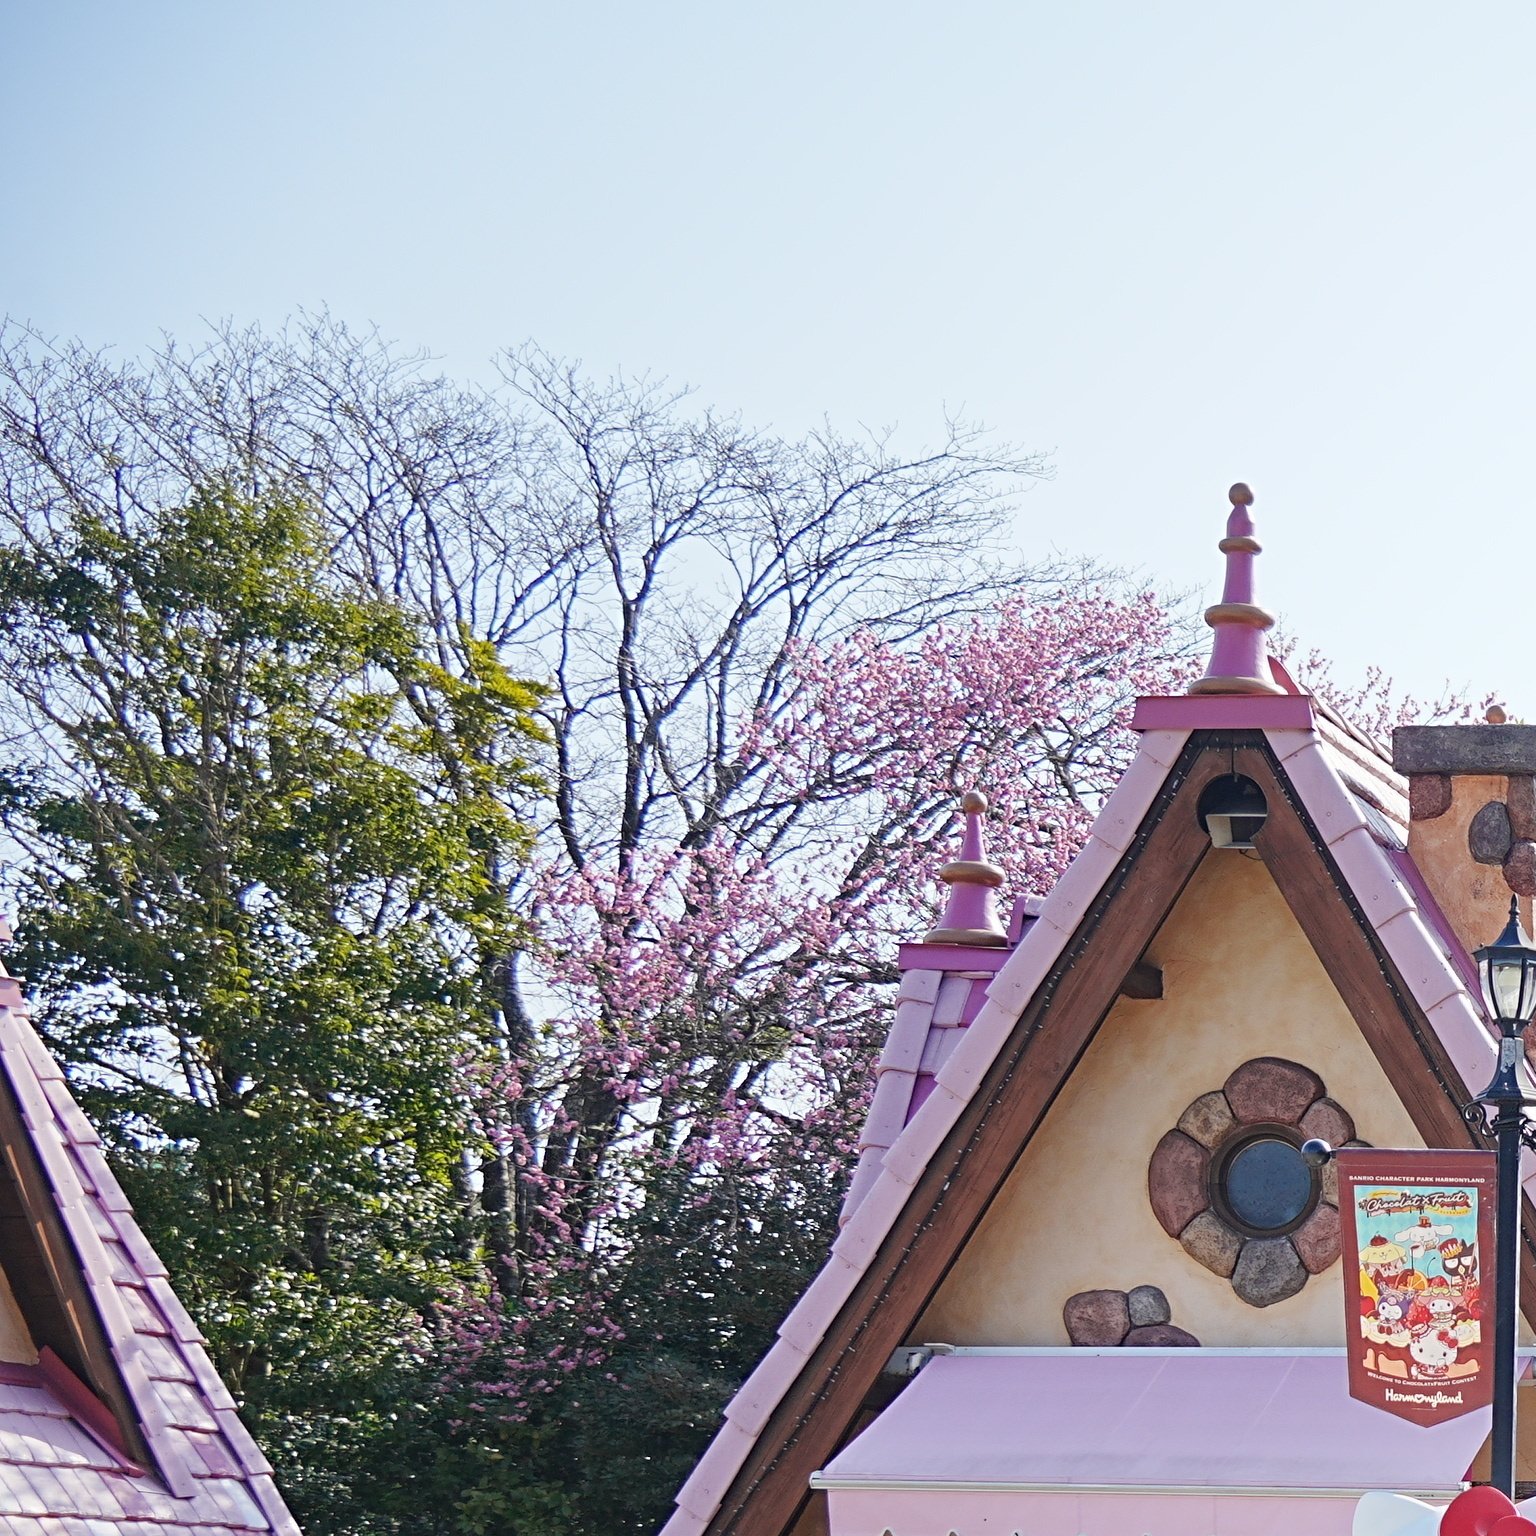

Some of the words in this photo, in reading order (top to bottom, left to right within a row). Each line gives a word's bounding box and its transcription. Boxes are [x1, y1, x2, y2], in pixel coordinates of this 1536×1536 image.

[1366, 1194, 1421, 1211] Chocolat
[1430, 1191, 1465, 1206] Fruit
[1385, 1388, 1463, 1408] Harmonyland
